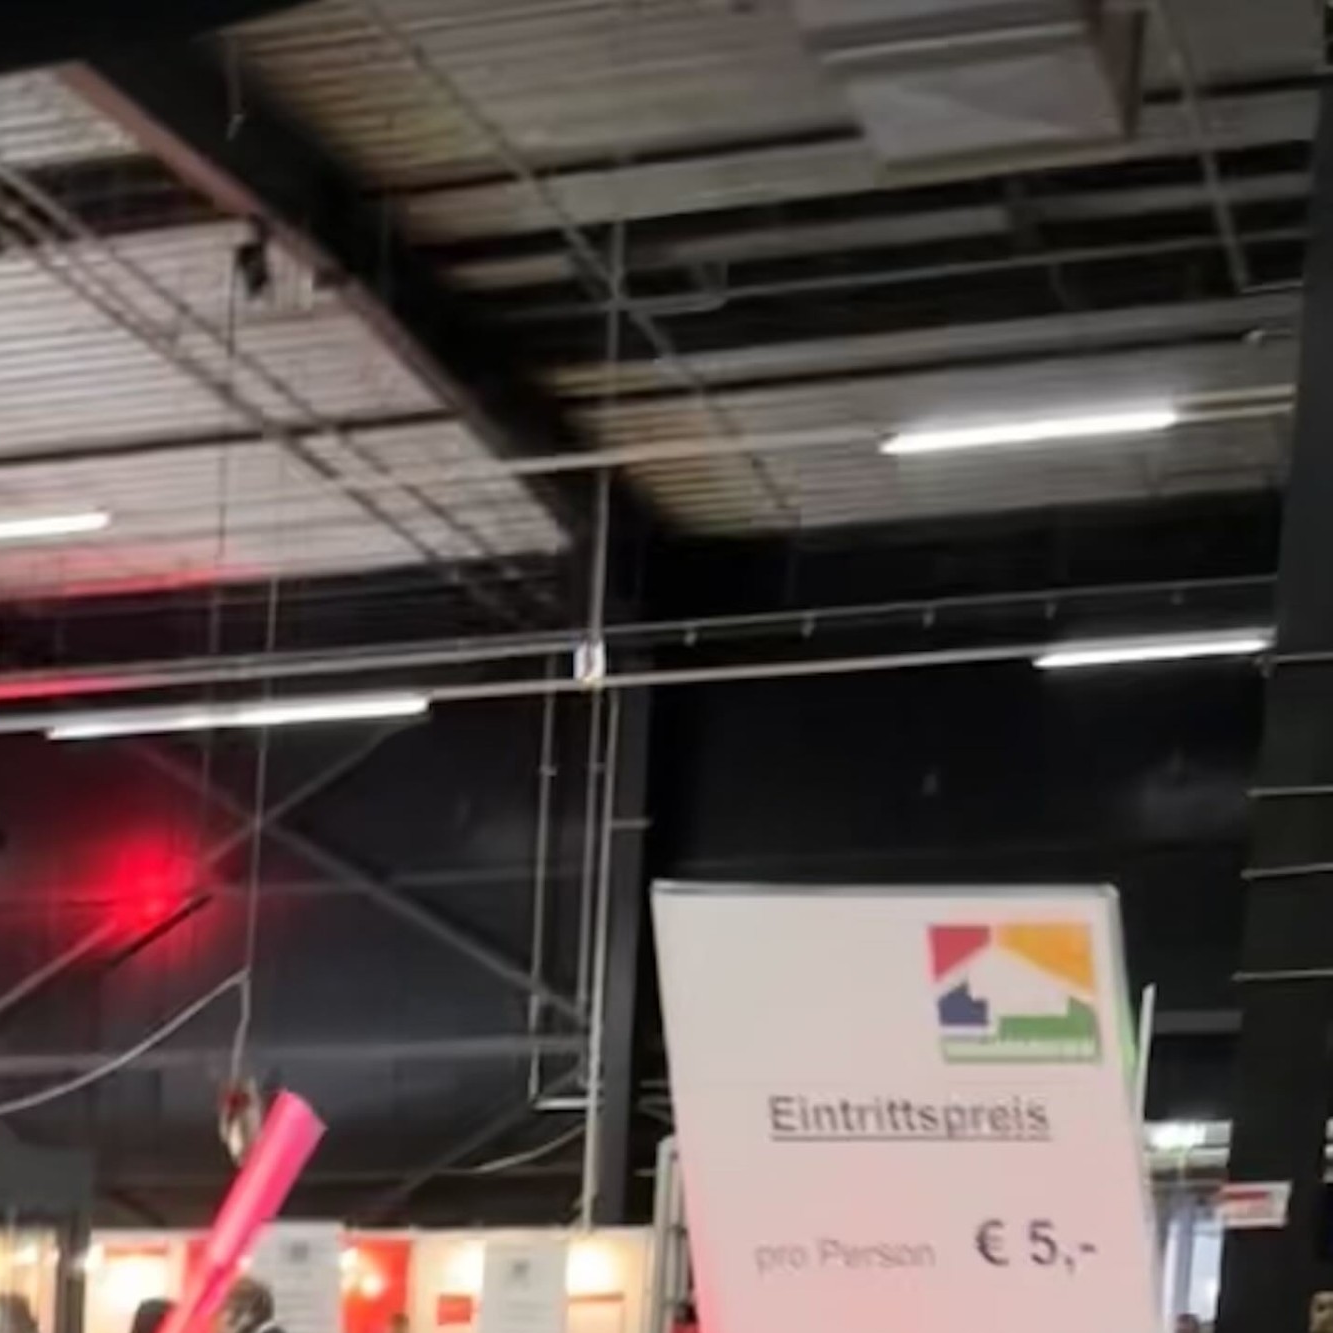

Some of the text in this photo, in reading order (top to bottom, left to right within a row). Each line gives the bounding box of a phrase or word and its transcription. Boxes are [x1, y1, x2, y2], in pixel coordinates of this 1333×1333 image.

[768, 1095, 1051, 1140] Eintrittspreis
[753, 1245, 809, 1281] pro
[816, 1239, 936, 1268] Person
[974, 1217, 1010, 1267] €
